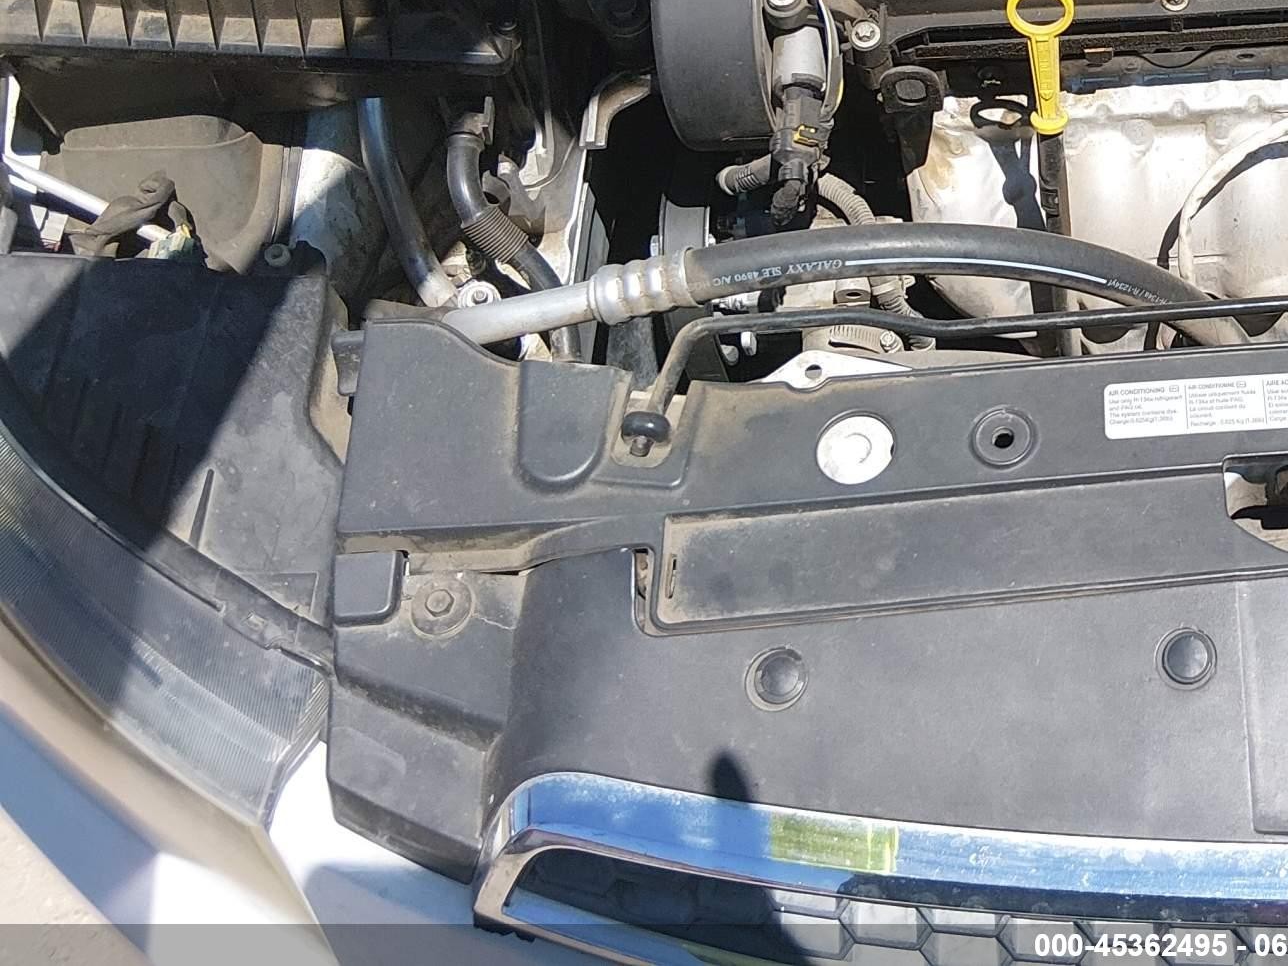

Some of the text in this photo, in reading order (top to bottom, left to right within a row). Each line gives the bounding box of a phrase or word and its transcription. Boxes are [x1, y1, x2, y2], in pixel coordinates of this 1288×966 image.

[786, 259, 843, 274] GALAXY
[712, 275, 731, 286] A/C
[734, 270, 759, 282] 4890
[1107, 279, 1140, 295] R-1234yf
[1120, 387, 1165, 395] CONDITIONING
